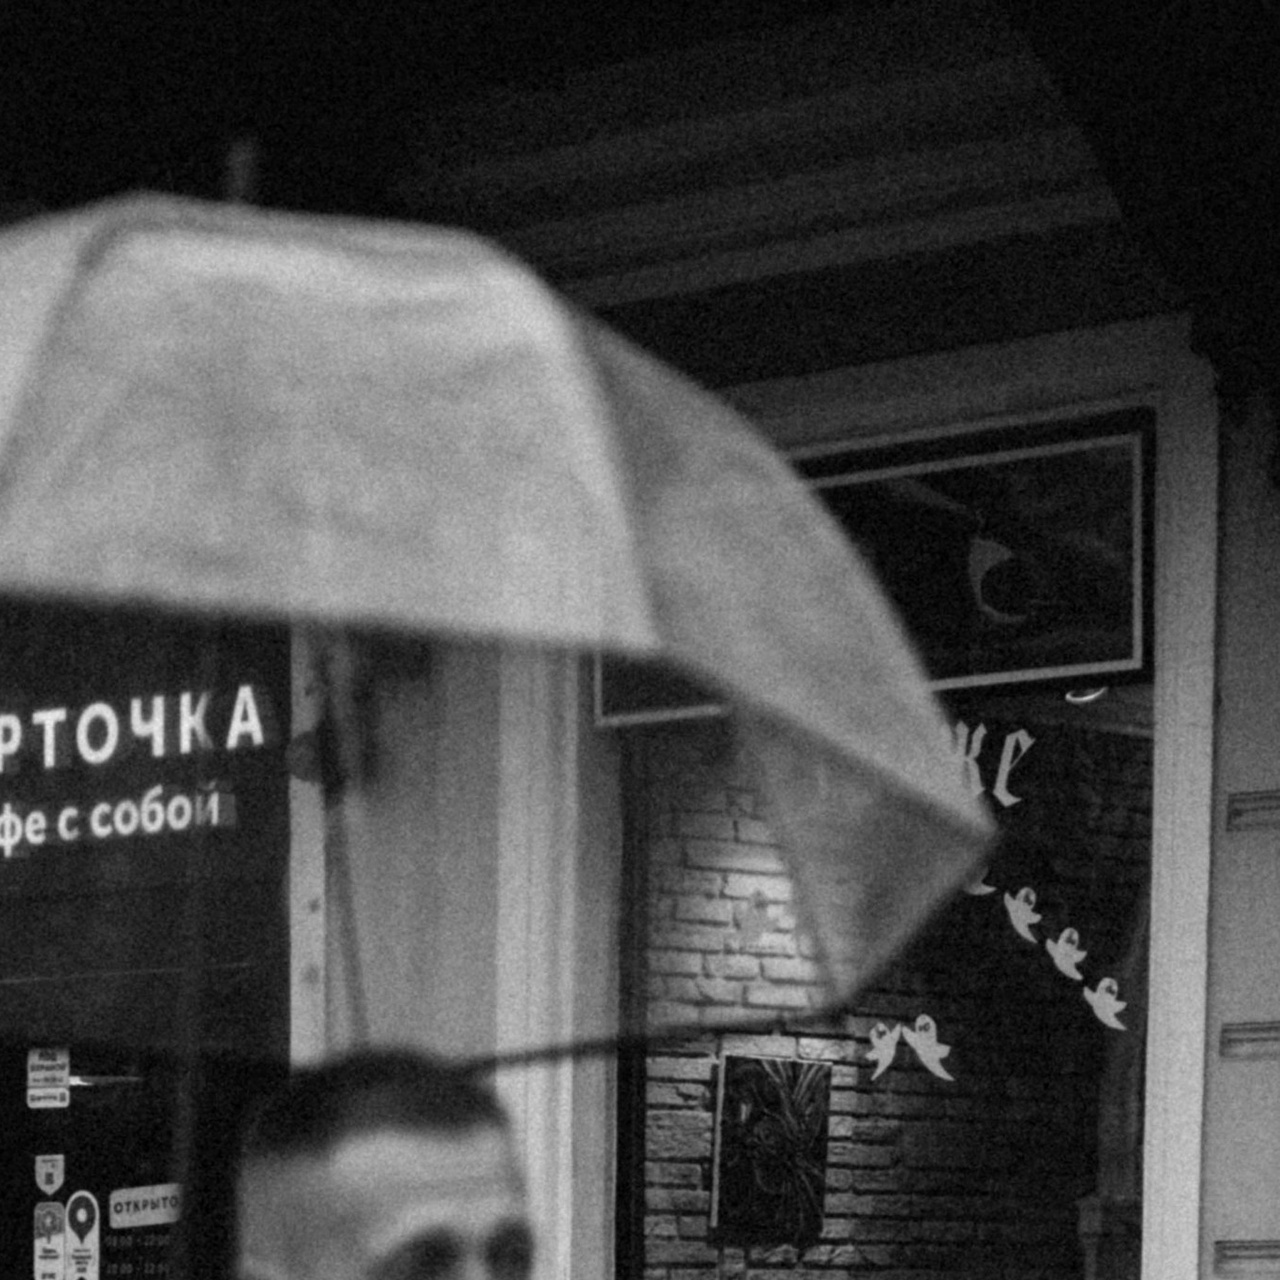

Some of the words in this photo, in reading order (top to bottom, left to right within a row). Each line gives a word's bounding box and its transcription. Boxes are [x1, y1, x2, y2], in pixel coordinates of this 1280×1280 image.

[57, 806, 80, 840] с
[90, 779, 219, 838] собой
[113, 1195, 179, 1214] ОТКРЫТО
